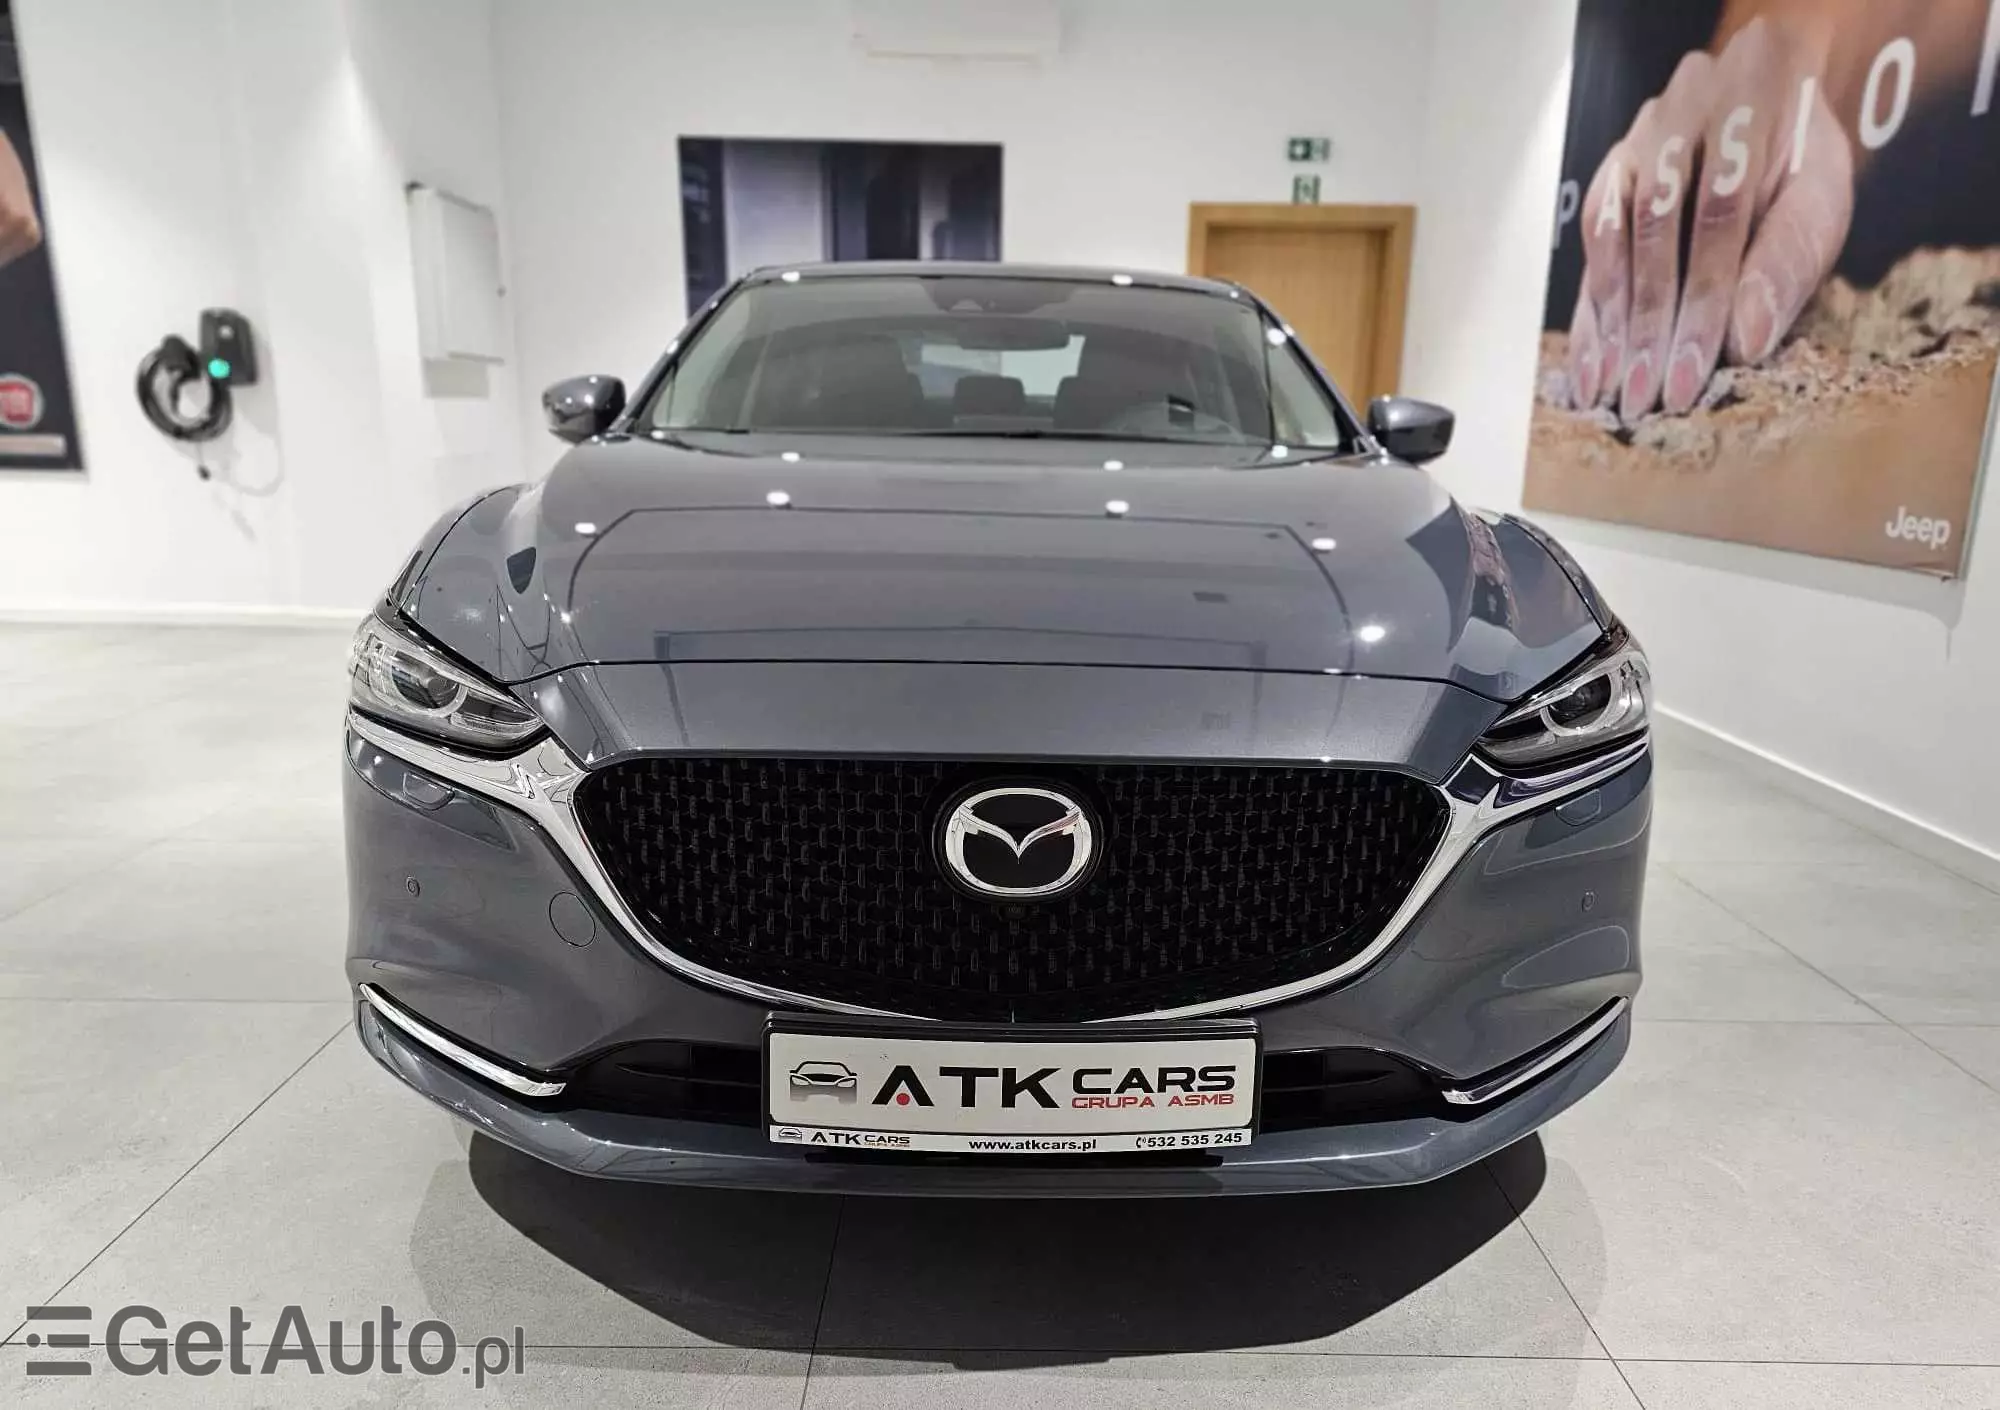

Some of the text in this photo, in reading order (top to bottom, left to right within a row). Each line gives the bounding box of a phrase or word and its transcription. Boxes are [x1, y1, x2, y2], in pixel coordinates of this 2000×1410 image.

[1885, 505, 1951, 550] Jeep
[872, 1065, 1236, 1108] ATK CARS
[1072, 1094, 1234, 1108] GRUPA ASMB
[811, 1132, 860, 1145] ATK
[864, 1134, 910, 1144] CARS
[969, 1138, 1097, 1151] www.atkcars.pl
[1148, 1132, 1243, 1148] 532 535 245
